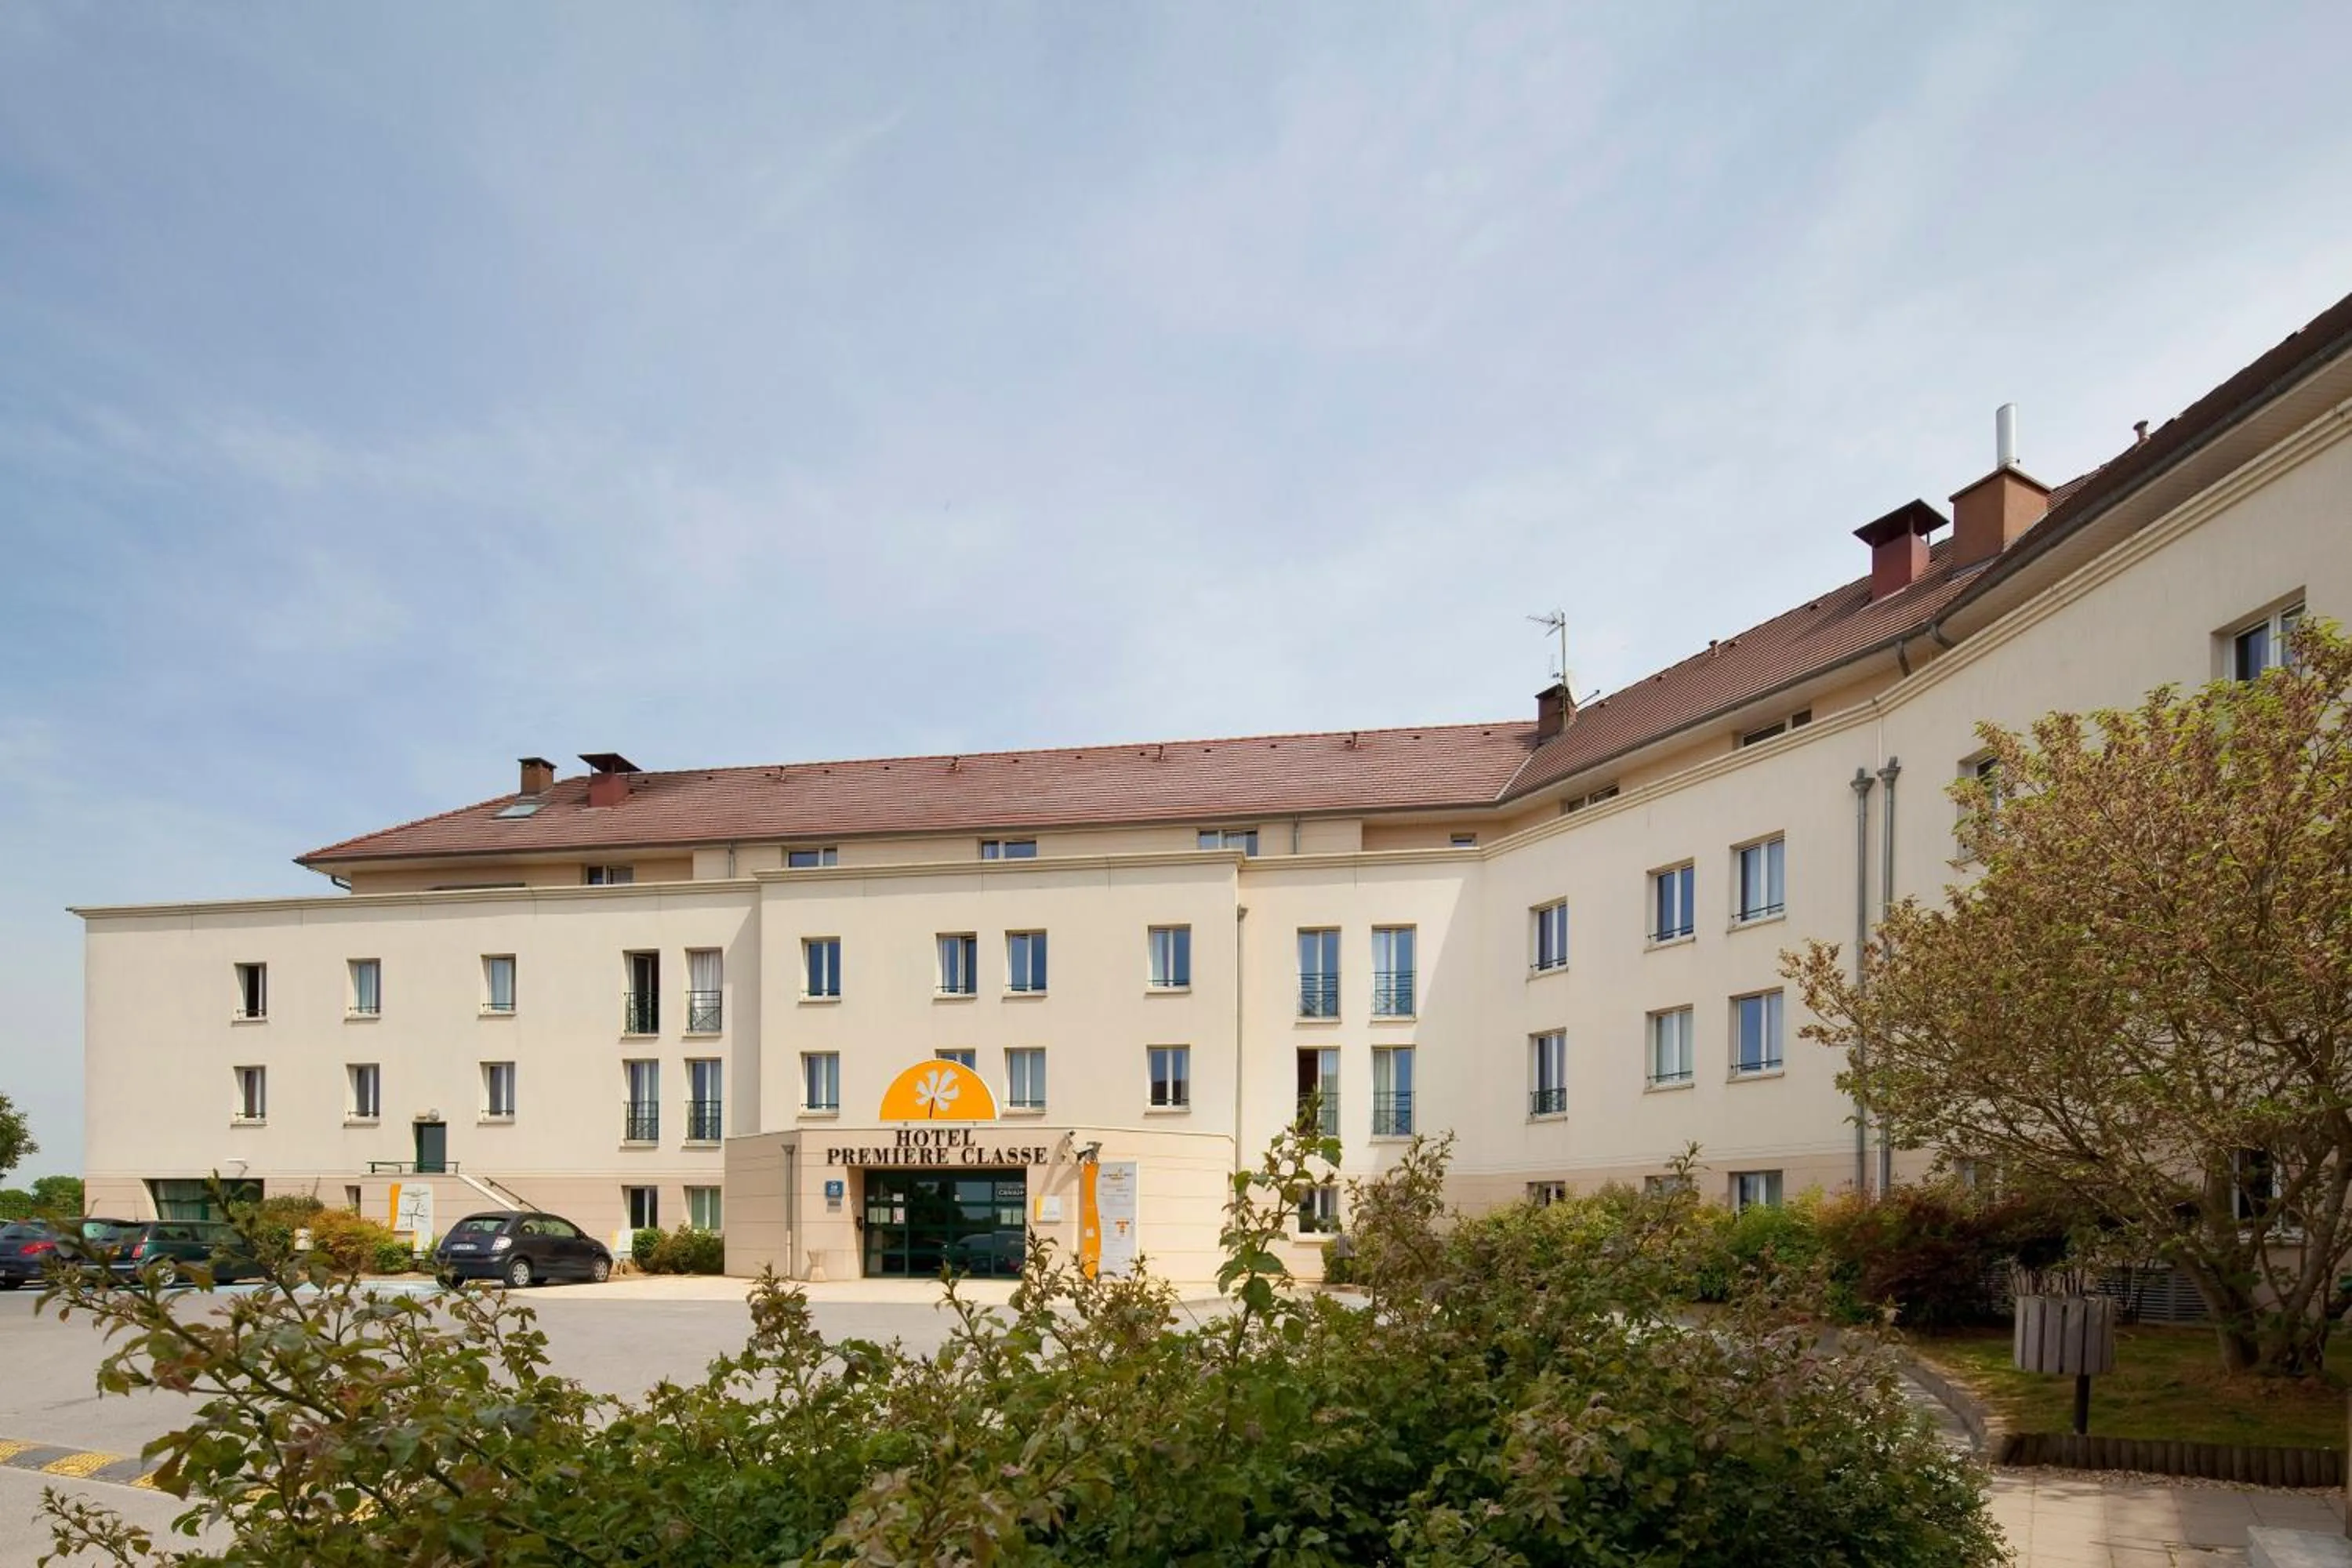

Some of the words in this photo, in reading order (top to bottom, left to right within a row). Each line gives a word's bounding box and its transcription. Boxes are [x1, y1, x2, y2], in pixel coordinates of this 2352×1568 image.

[895, 1129, 976, 1147] HOTEL
[827, 1147, 949, 1164] PREMIERE
[961, 1147, 1047, 1164] CLASSE
